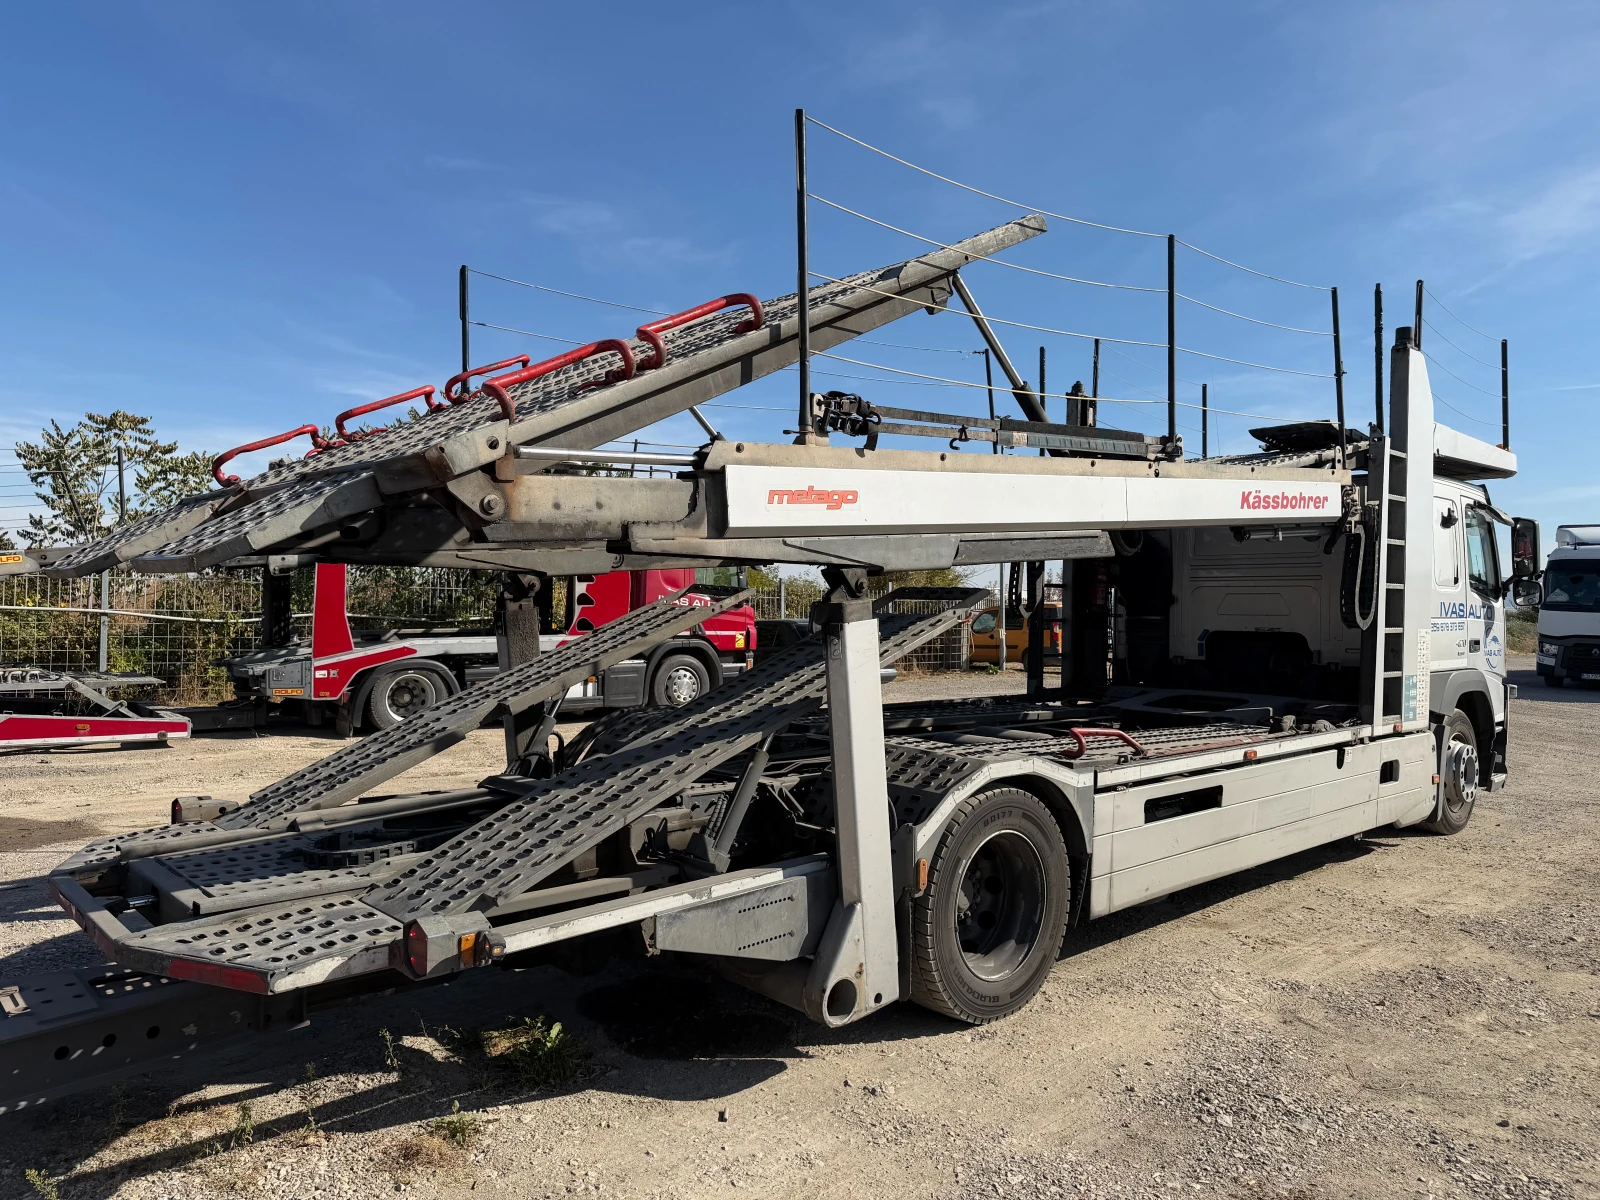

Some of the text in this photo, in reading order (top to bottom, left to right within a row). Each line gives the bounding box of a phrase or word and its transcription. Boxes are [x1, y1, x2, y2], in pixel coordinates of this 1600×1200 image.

[767, 485, 858, 510] metago
[1240, 490, 1329, 510] Kässbohrer
[0, 555, 21, 563] LFO
[1439, 601, 1493, 620] IVAS AUTO
